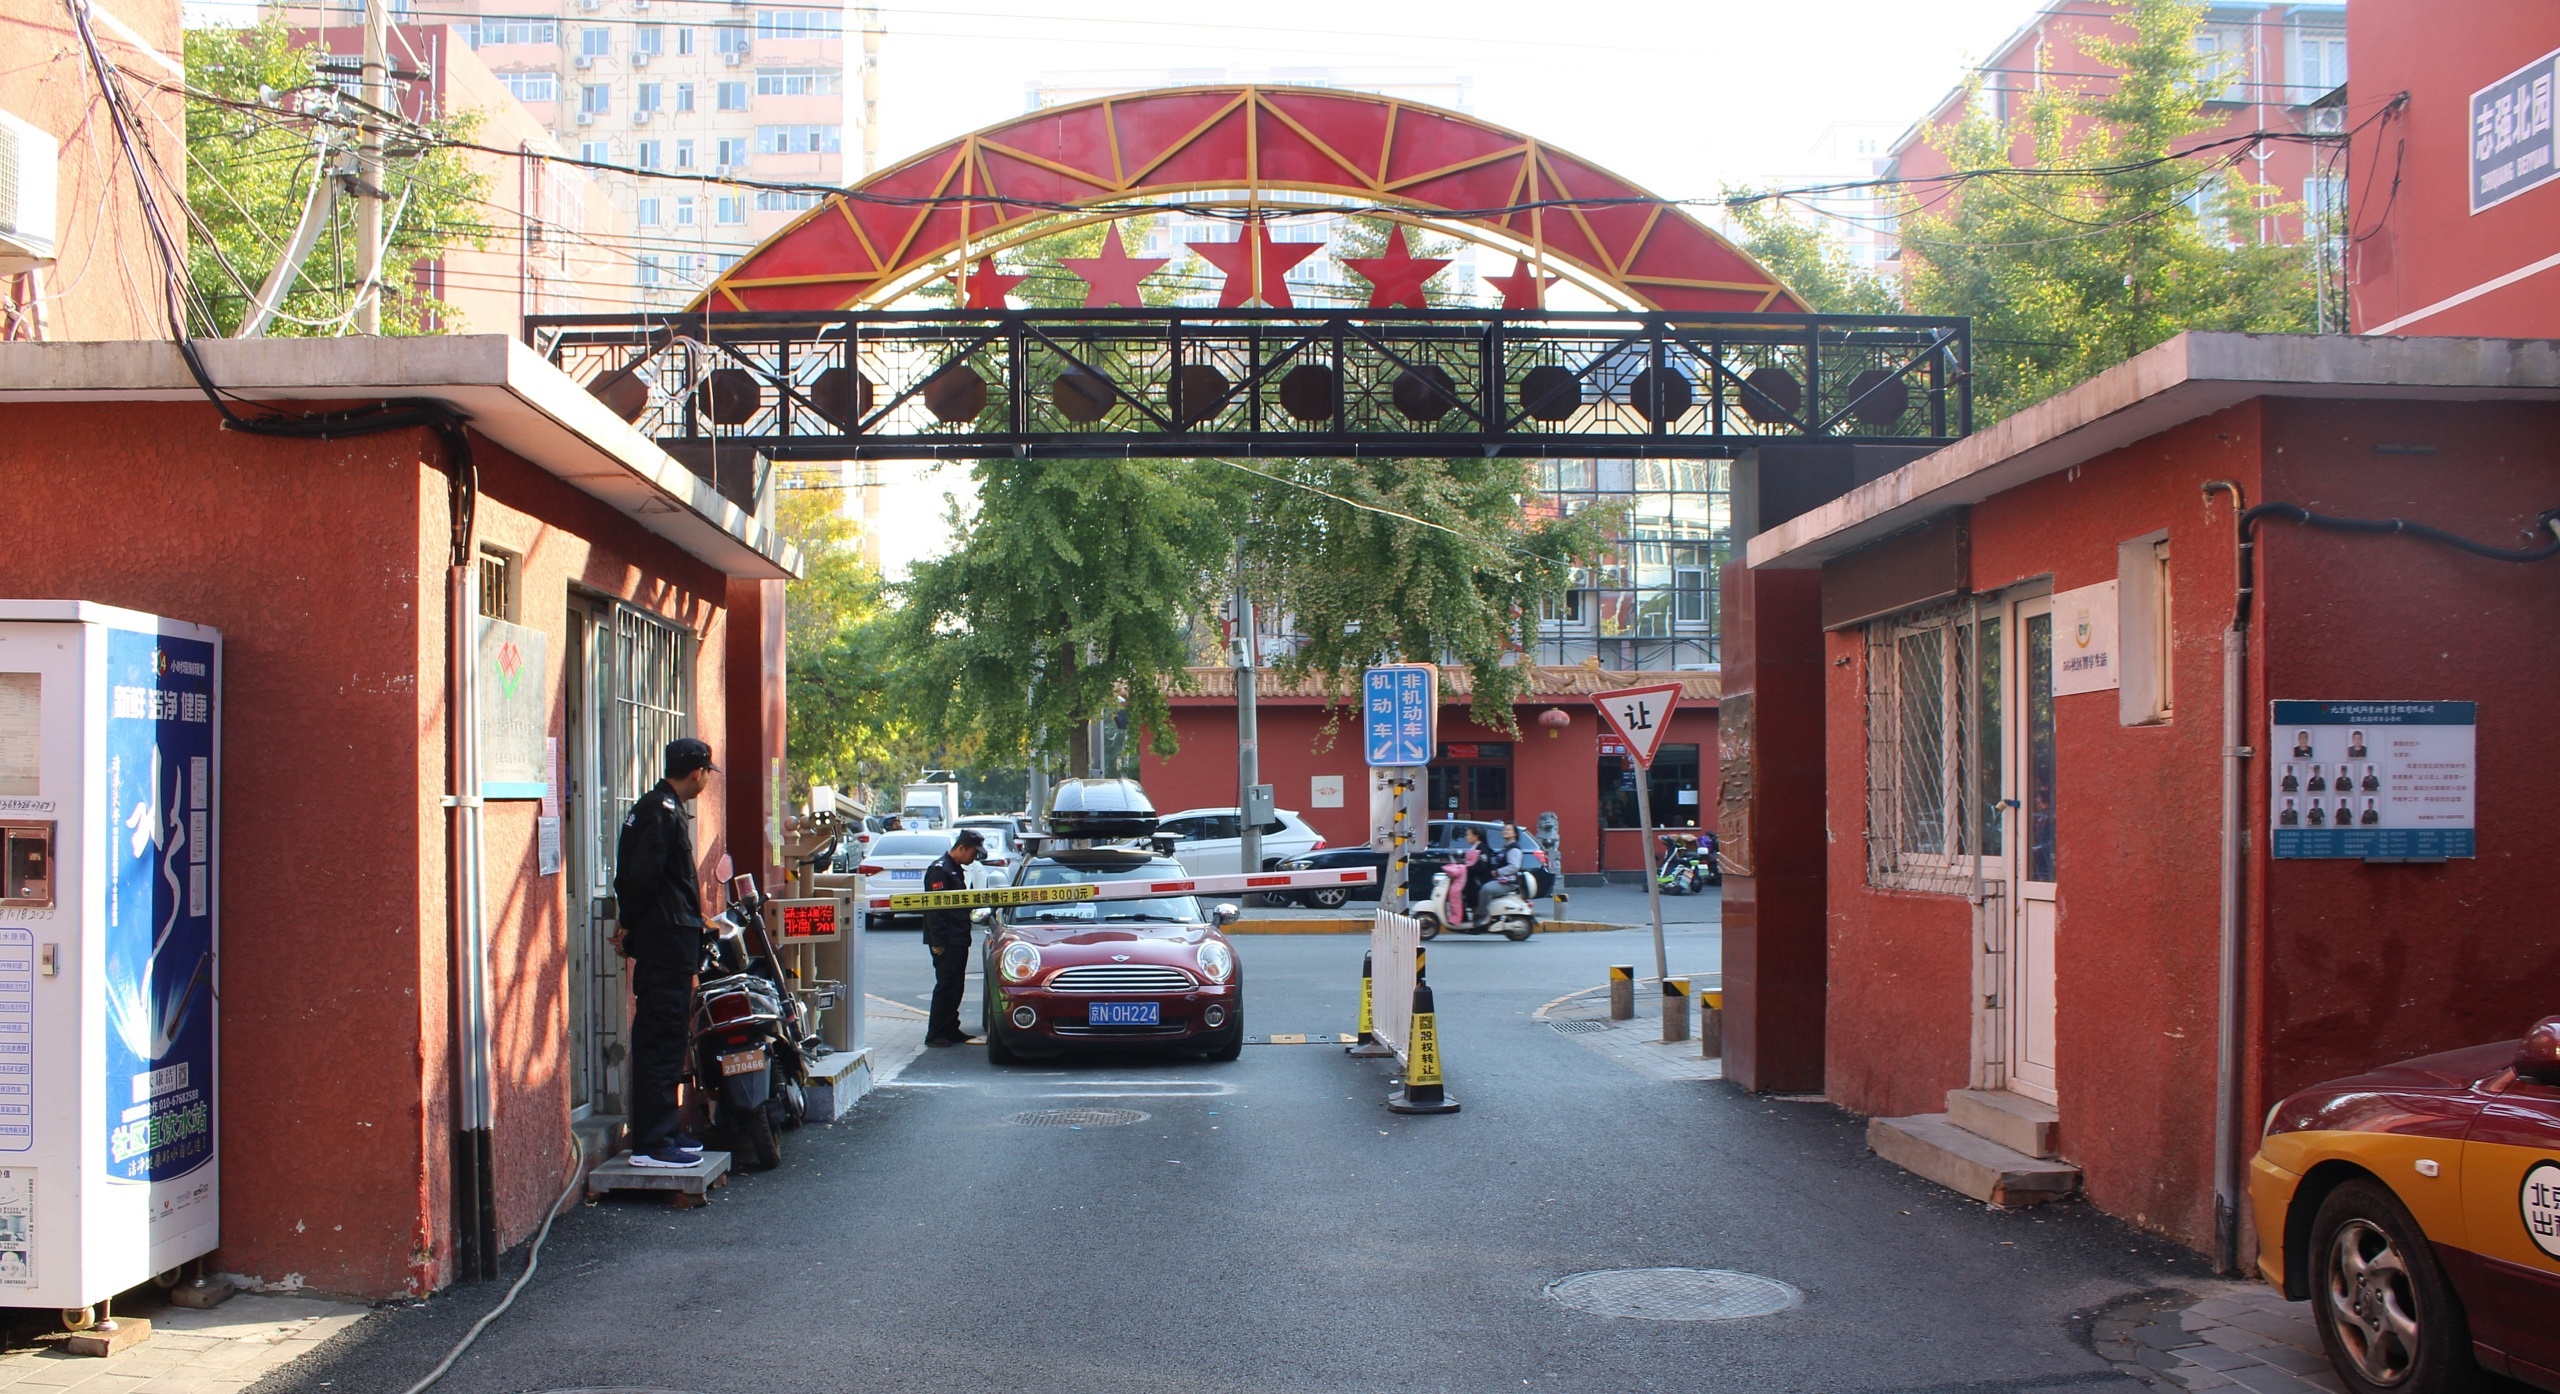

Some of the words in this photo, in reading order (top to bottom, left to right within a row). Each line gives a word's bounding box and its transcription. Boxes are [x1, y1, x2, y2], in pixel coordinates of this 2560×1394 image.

[2476, 72, 2551, 161] 志强北园
[181, 691, 208, 723] 健康
[1371, 674, 1392, 737] 机动车
[1402, 673, 1423, 737] 非机动车
[1624, 701, 1652, 730] 让
[894, 896, 929, 908] 一车一杆
[934, 893, 970, 906] 请勿跟车
[1012, 889, 1048, 903] 损坏赔偿
[1052, 888, 1088, 900] 3000元
[725, 1060, 764, 1074] 2370466
[1420, 1030, 1434, 1075] 股权转让
[159, 1089, 200, 1112] 010-67682588
[112, 1101, 208, 1164] 社区直饮水站
